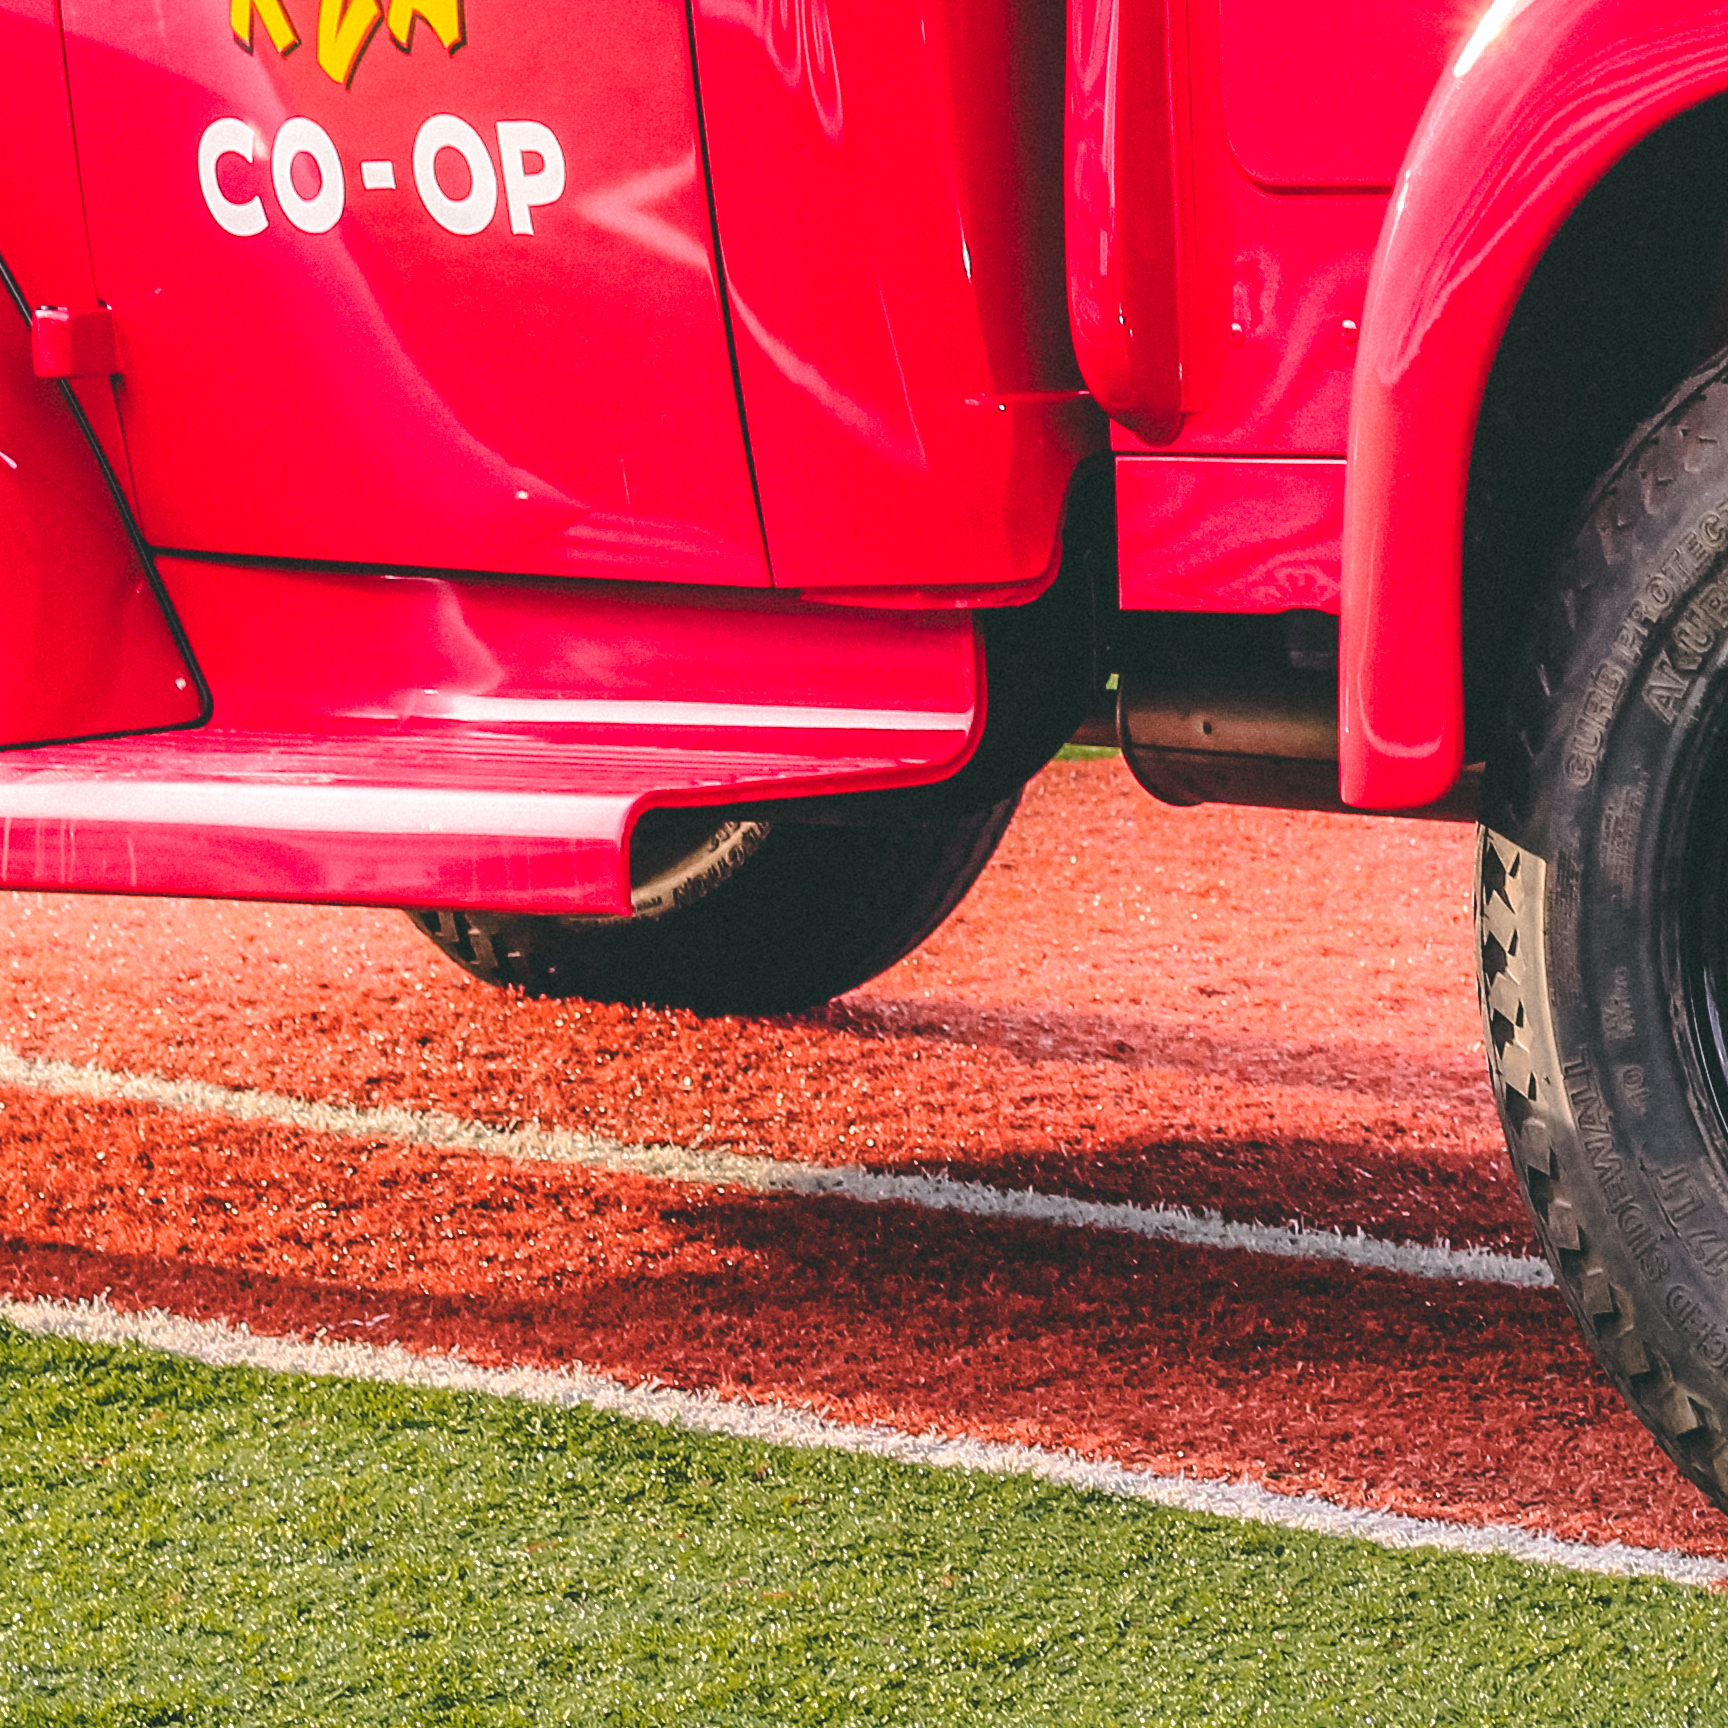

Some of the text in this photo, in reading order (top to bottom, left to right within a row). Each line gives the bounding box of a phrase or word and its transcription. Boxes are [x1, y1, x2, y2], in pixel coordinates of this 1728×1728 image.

[197, 113, 566, 236] CO-OP
[1569, 661, 1626, 786] CURB
[1563, 1045, 1670, 1282] SIDEWALL
[1659, 1166, 1705, 1222] LT
